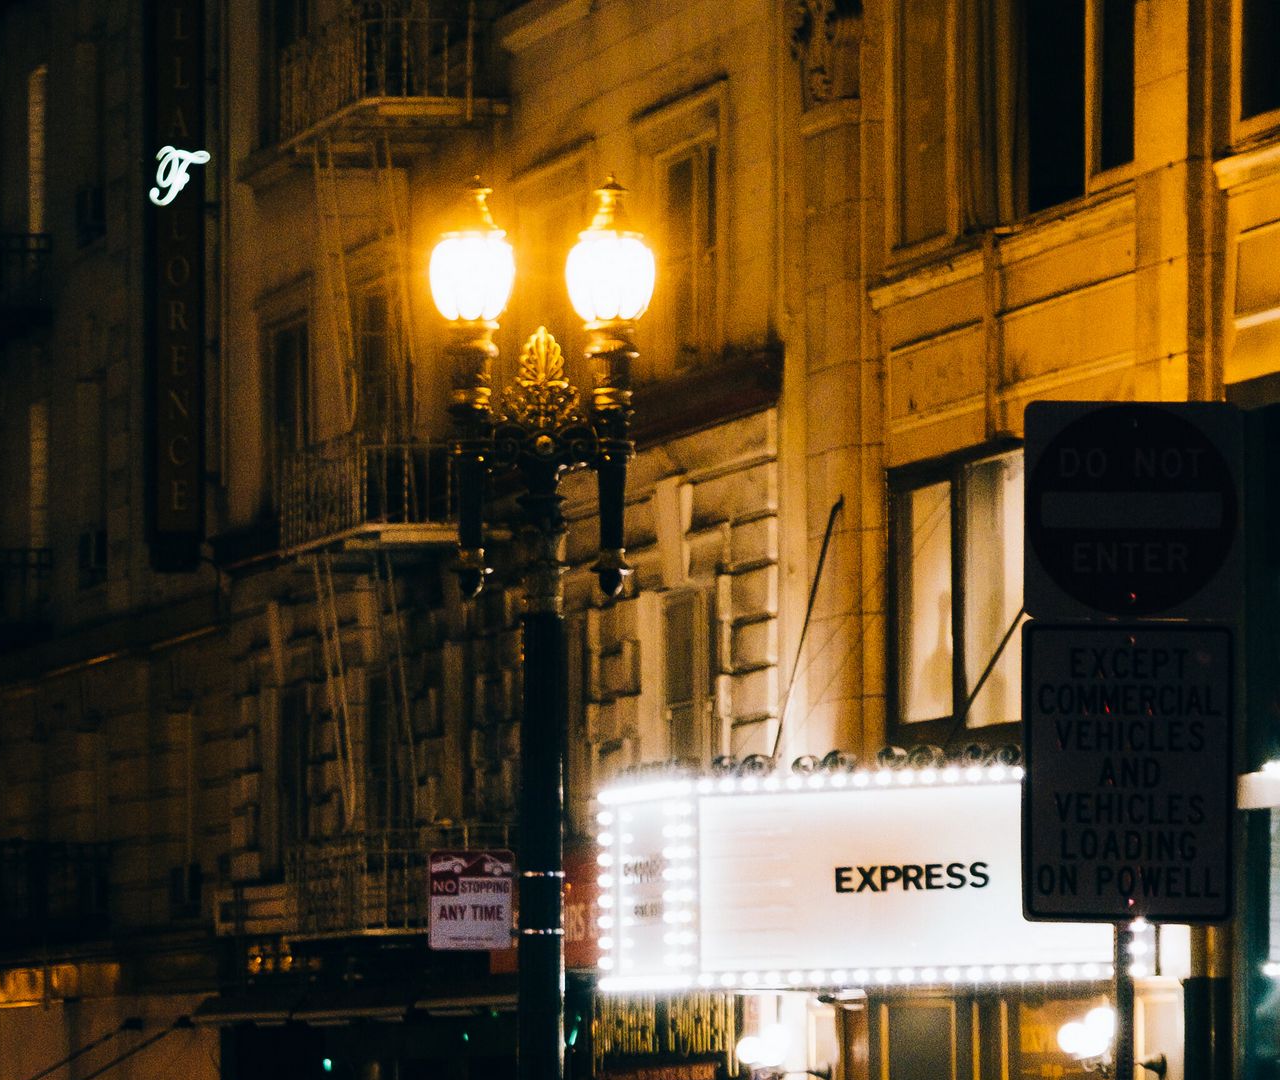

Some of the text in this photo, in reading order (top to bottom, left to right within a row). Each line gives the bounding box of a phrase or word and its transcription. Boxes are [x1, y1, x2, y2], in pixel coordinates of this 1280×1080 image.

[1058, 448, 1206, 478] DO NOT
[1072, 542, 1189, 573] ENTER
[1070, 649, 1189, 679] EXCEPT
[1039, 684, 1221, 716] COMMERCIAL
[1056, 721, 1205, 751] VEHICLES
[1099, 757, 1161, 788] AND
[1055, 794, 1205, 825] VEHICLES
[1061, 830, 1197, 861] LOADING
[432, 880, 511, 894] NO STOPPING
[835, 861, 990, 893] EXPRESS
[1038, 864, 1220, 898] ON POWELL
[440, 904, 505, 921] ANY TIME
